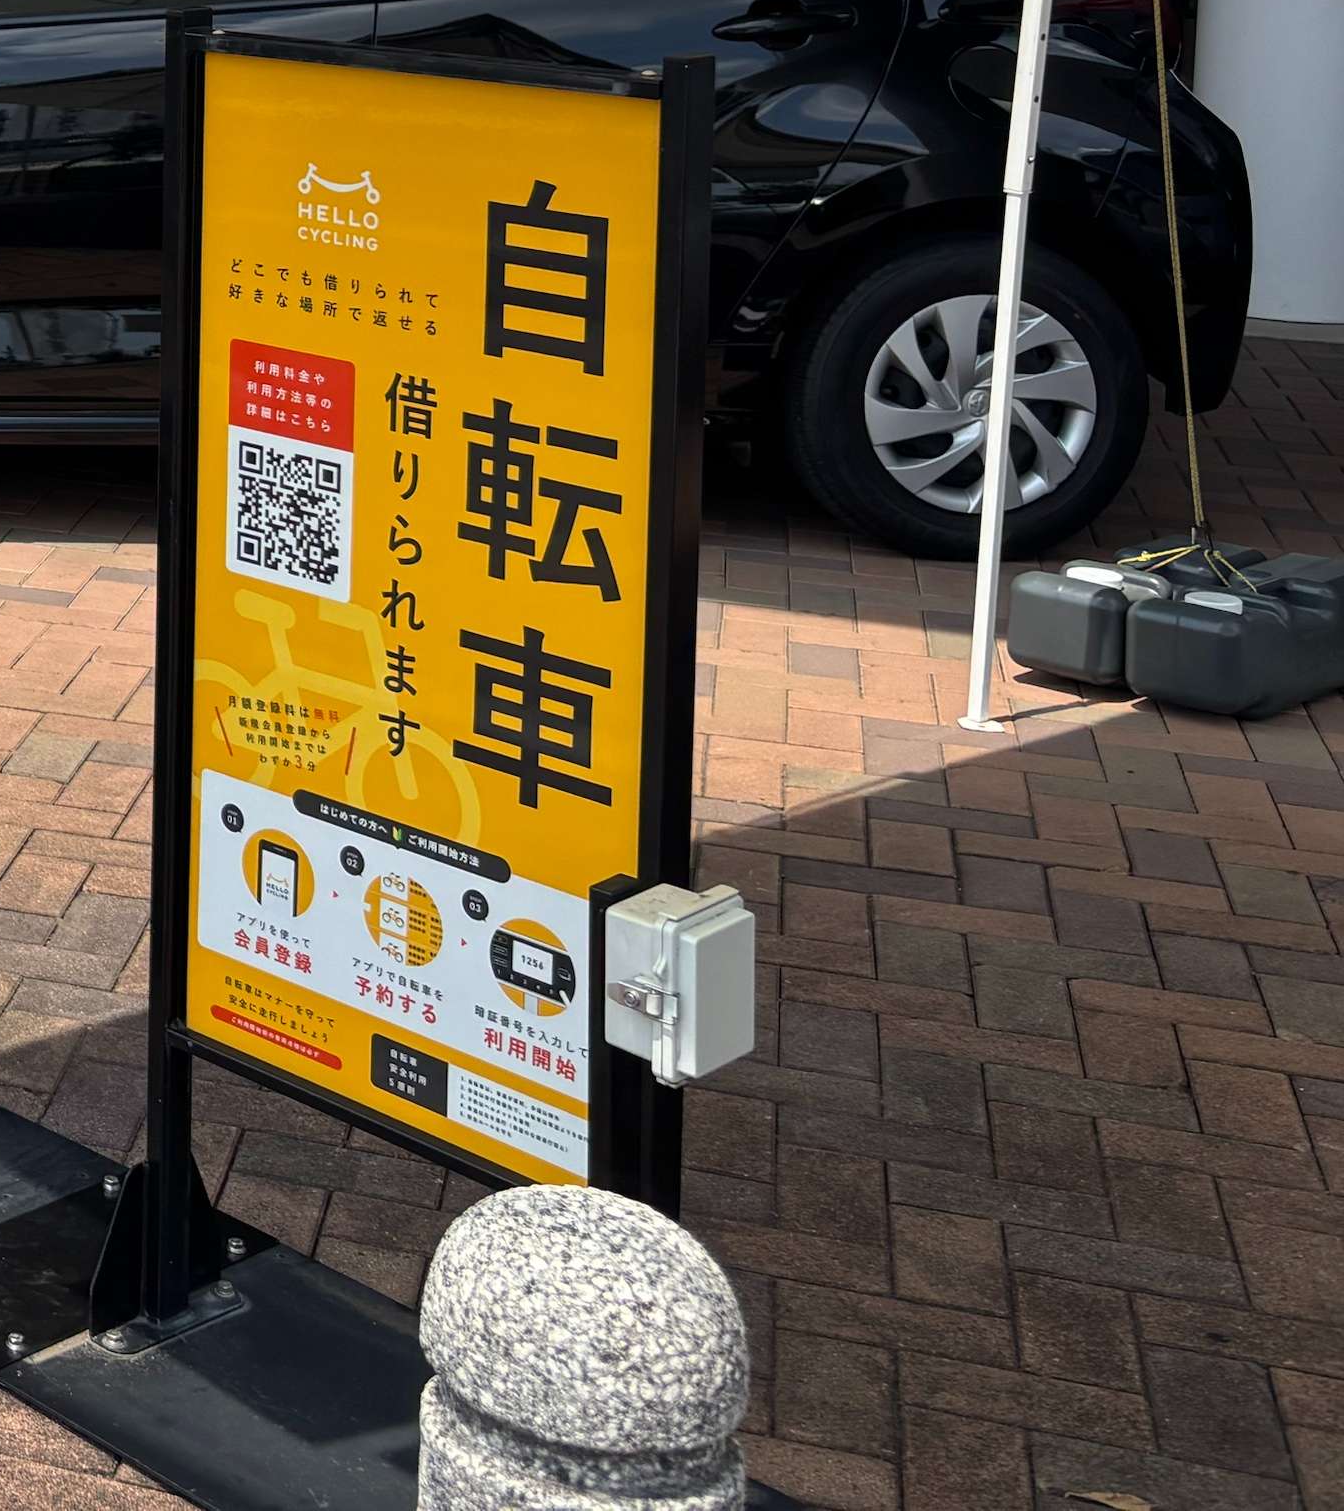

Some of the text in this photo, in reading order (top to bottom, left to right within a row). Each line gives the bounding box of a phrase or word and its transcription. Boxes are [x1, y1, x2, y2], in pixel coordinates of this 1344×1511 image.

[298, 202, 379, 230] HELLO
[298, 226, 379, 252] CYCLING
[230, 258, 439, 308] どこでも借りられて
[228, 284, 437, 336] 好きな場所で返せる
[246, 380, 332, 410] 利用方法等の
[254, 360, 325, 386] 利用料金や
[246, 402, 331, 433] 詳細はこちら
[453, 180, 621, 809] 自転車
[379, 372, 437, 757] 借りられます
[227, 814, 238, 826] 01
[320, 803, 480, 868] はじめての方へ ご利用開始方法
[346, 858, 358, 869] 02
[234, 929, 312, 974] 会員登録
[235, 912, 311, 948] アプリを使って
[352, 957, 444, 1002] アプリで自転車を
[355, 975, 436, 1024] 予約する
[475, 1004, 589, 1058] 暗証番号を入力して
[484, 1027, 577, 1082] 利用開始
